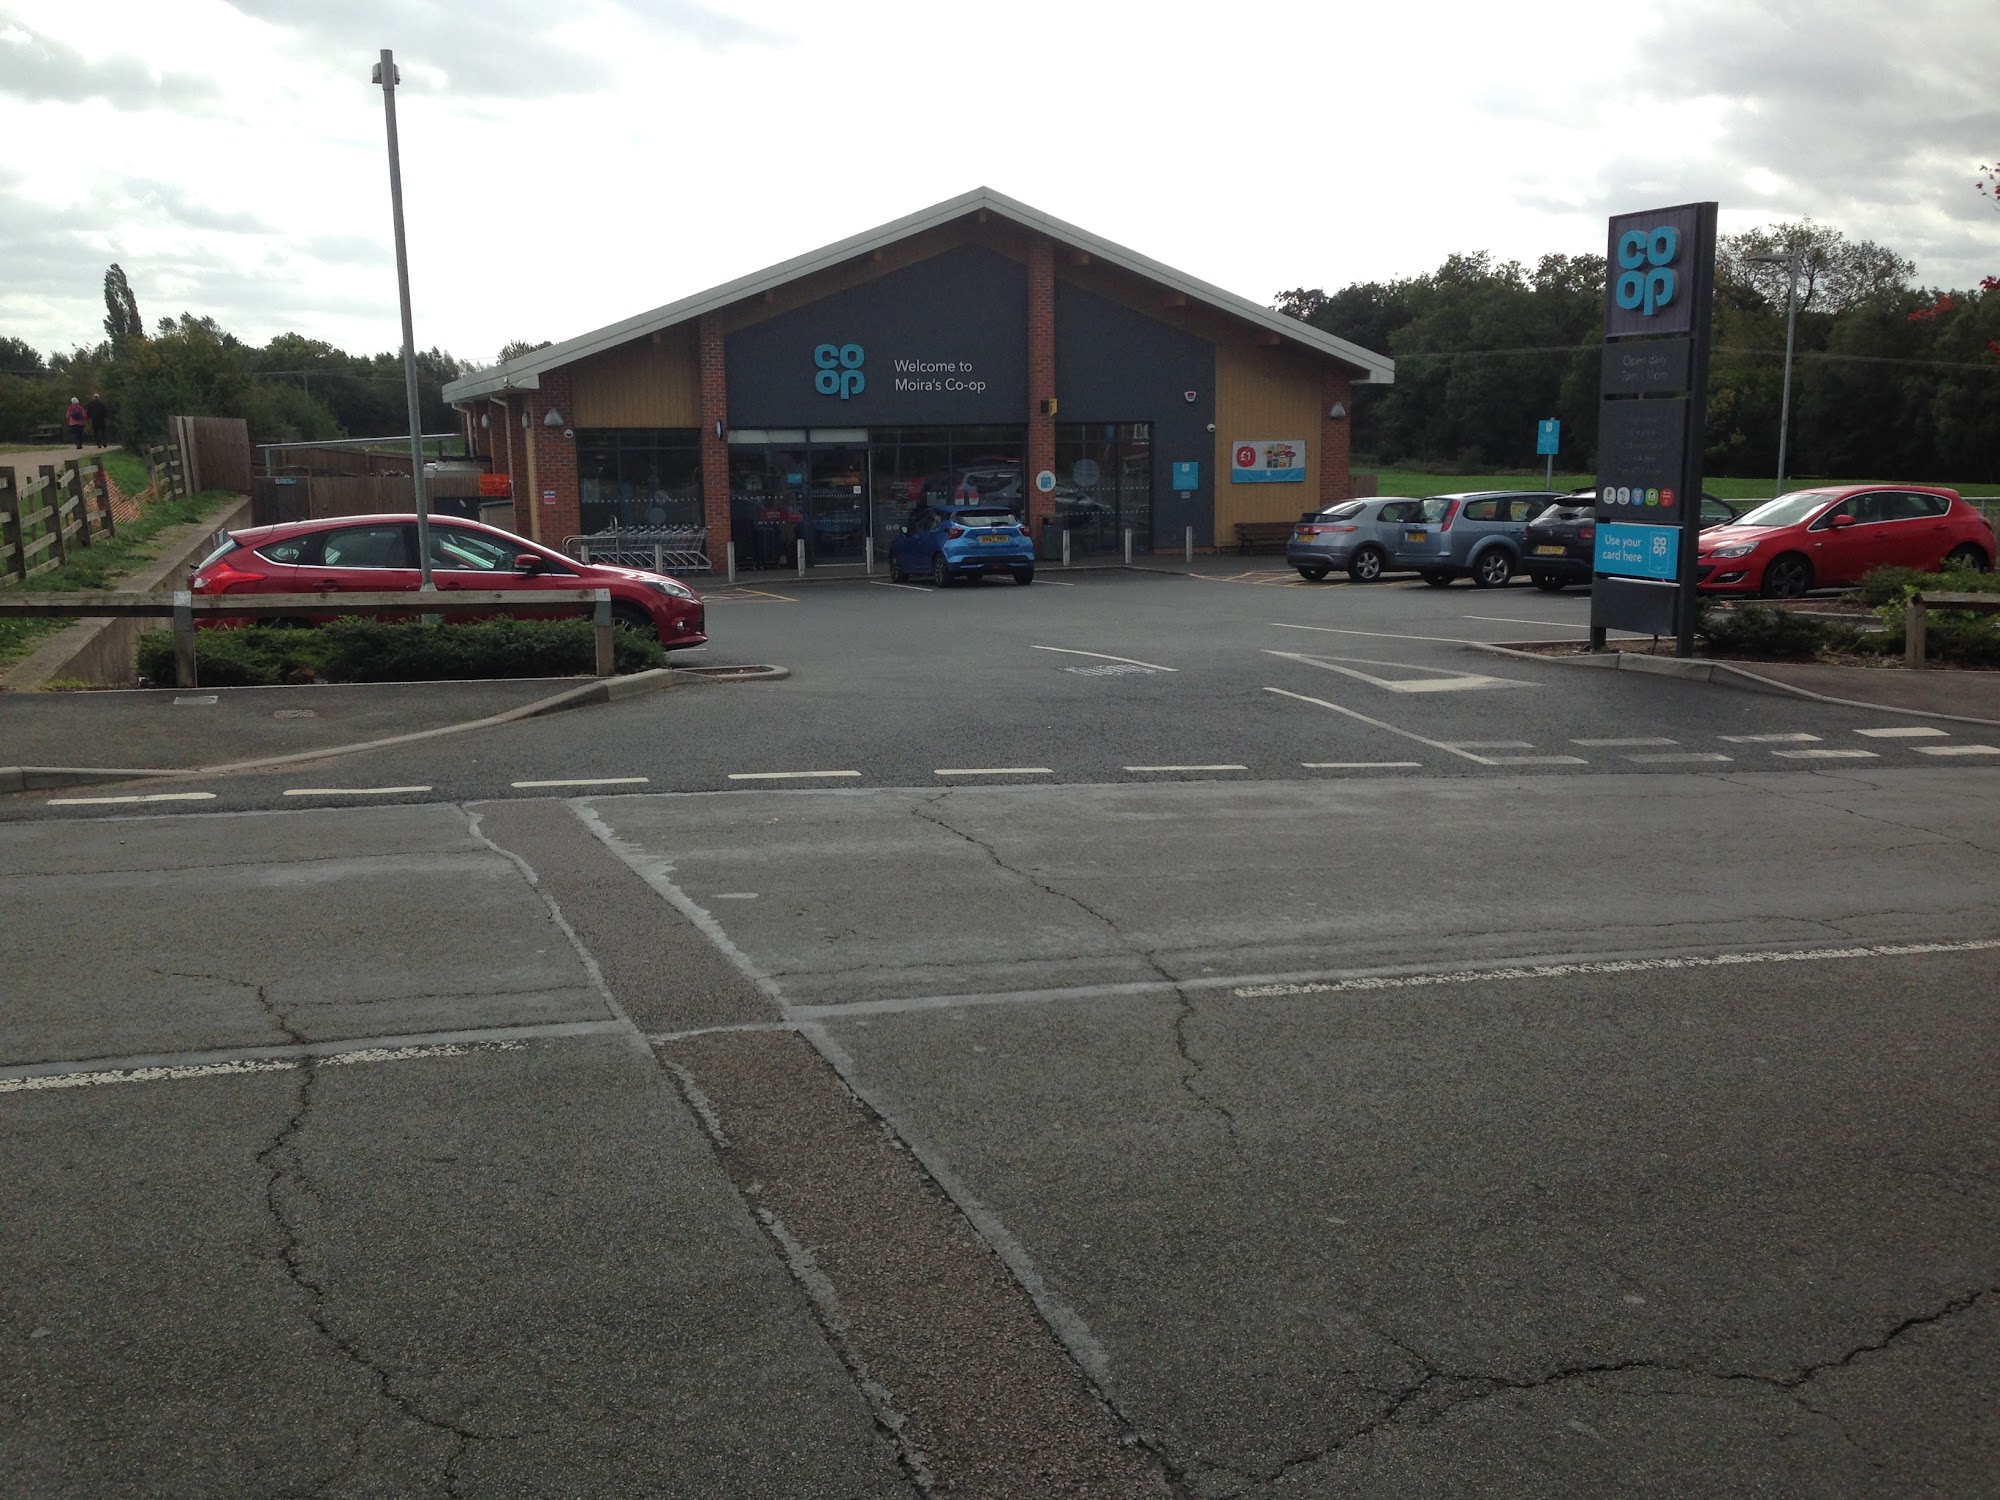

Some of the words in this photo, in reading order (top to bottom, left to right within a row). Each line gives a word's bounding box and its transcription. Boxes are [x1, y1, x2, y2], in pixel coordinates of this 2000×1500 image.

[894, 359, 956, 373] Welcome
[959, 360, 973, 373] to
[895, 378, 942, 391] Moira's
[945, 378, 986, 394] Co-op
[1240, 451, 1251, 461] £1
[1604, 534, 1621, 546] Use
[1622, 537, 1642, 549] your
[1602, 550, 1621, 561] card
[1623, 550, 1643, 562] here
